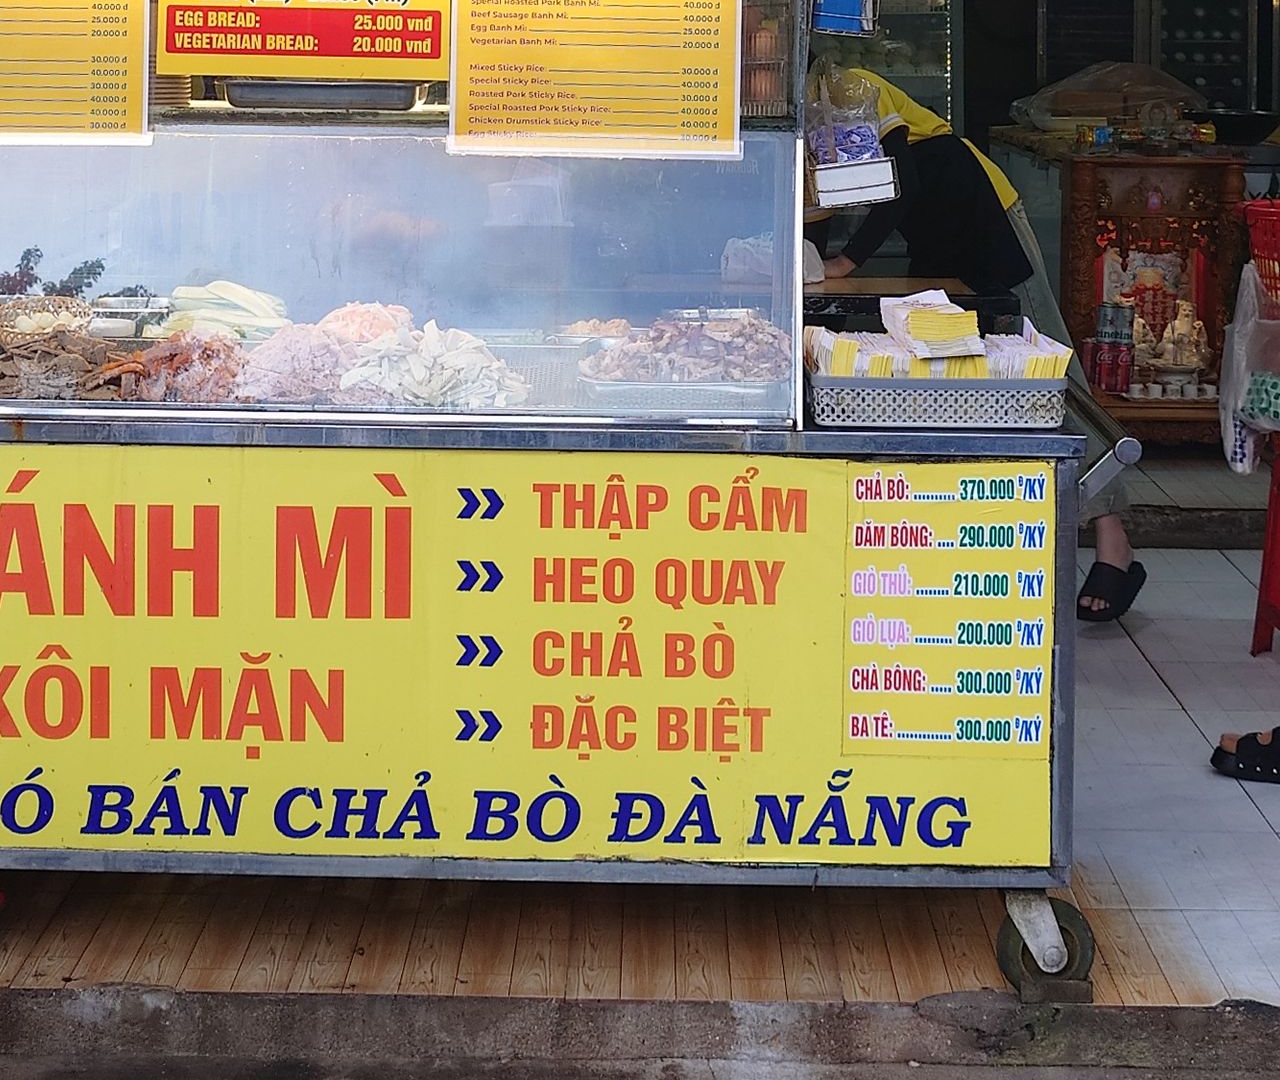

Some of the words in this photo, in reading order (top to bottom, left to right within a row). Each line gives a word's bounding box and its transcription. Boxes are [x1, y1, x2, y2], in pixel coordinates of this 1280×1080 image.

[175, 11, 204, 27] EGG
[207, 12, 261, 28] BREAD:
[353, 15, 404, 31] 25.000
[174, 33, 262, 50] VEGETARIAN
[266, 35, 319, 51] BREAD:
[352, 37, 402, 53] 20.000
[470, 37, 517, 45] Vegetarian
[856, 472, 883, 500] CHẢ
[887, 473, 909, 500] BÒ:
[960, 479, 1015, 500] 370.000
[532, 473, 668, 541] THẬP
[687, 466, 809, 534] CẨM
[274, 472, 413, 620] MÌ
[855, 522, 885, 547] DĂM
[890, 522, 933, 548] BÔNG:
[959, 525, 1014, 547] 290.000
[532, 557, 635, 604] HEO
[654, 558, 786, 610] QUAY
[853, 565, 876, 595] GIÒ
[881, 566, 911, 595] THỦ:
[953, 574, 1008, 596] 210.000
[532, 616, 642, 678] CHẢ
[664, 622, 736, 679] BÒ
[852, 614, 875, 643] GIÒ
[880, 620, 910, 649] LỤA:
[957, 622, 1012, 645] 200.000
[851, 665, 878, 691] CHÀ
[884, 664, 926, 692] BÔNG:
[956, 671, 1011, 694] 300.000
[149, 651, 345, 760] MẶN
[529, 694, 638, 761] ĐẶC
[656, 697, 772, 763] BIỆT
[851, 715, 869, 737] BA
[873, 712, 892, 738] TÊ:
[956, 719, 1010, 741] 300.000
[80, 767, 249, 837] BÁN
[272, 770, 441, 840] CHẢ
[465, 774, 583, 843] BÒ
[607, 776, 722, 845] ĐÀ
[746, 767, 973, 848] NẴNG
